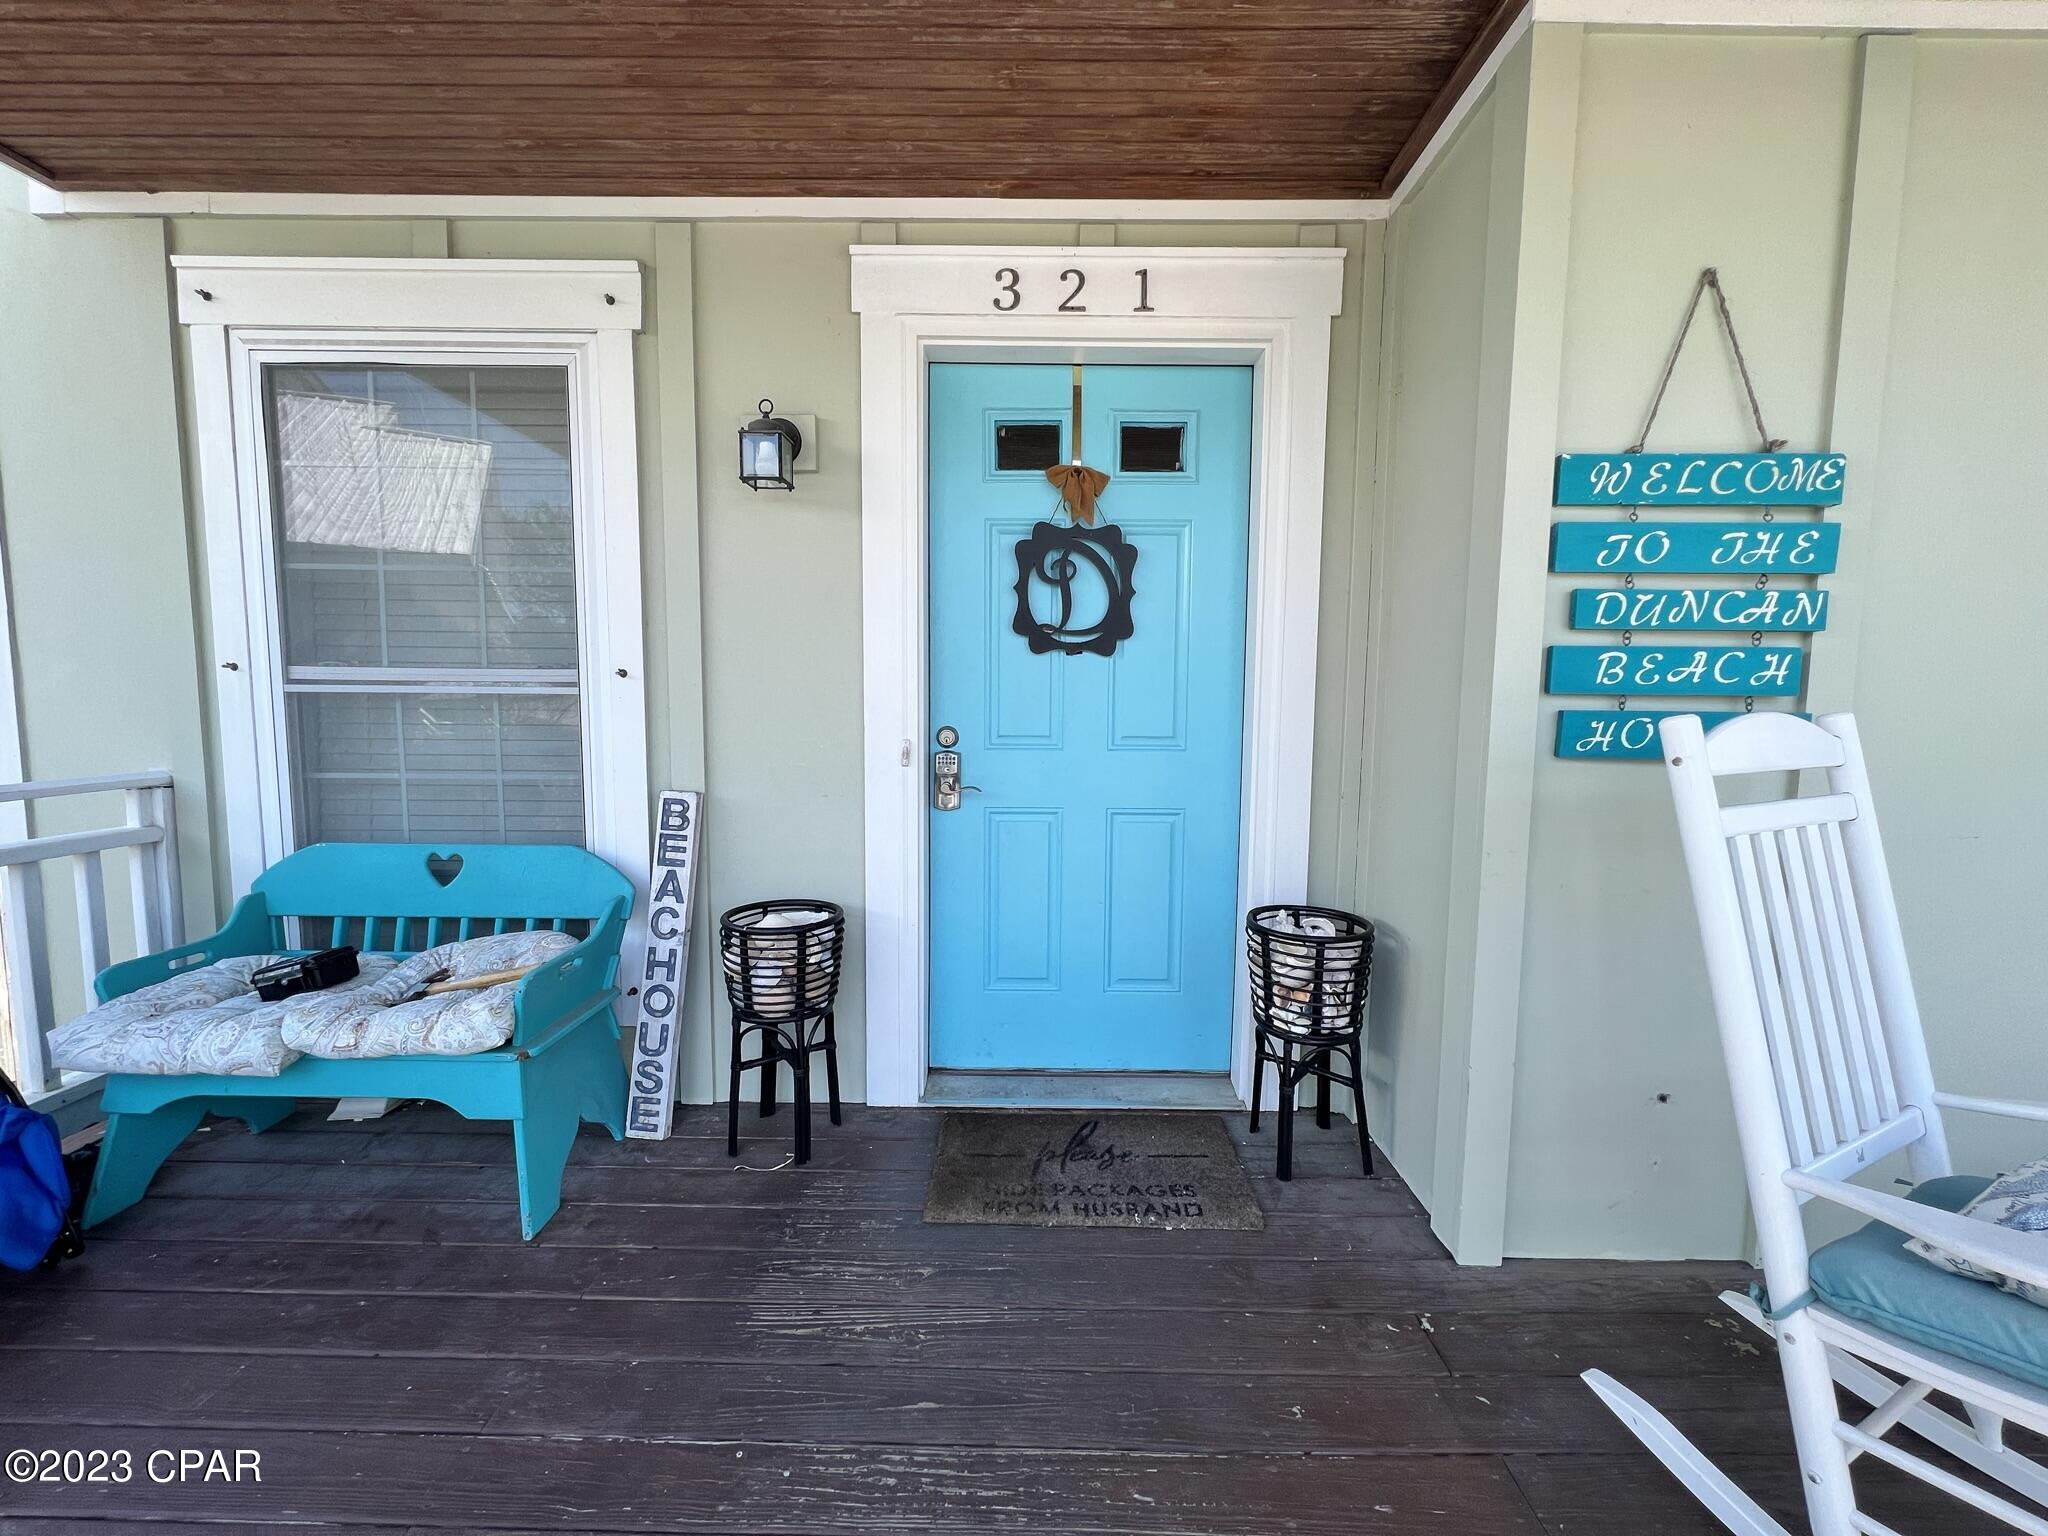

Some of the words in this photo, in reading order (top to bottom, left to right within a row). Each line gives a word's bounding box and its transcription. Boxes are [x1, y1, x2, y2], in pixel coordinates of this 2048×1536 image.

[993, 267, 1155, 312] 321
[1589, 457, 1846, 495] WELCOME
[1596, 530, 1671, 567] TO
[1711, 529, 1820, 565] THE
[1594, 589, 1825, 627] DUNCAN
[1595, 650, 1794, 687] BEACH
[628, 797, 691, 1134] BEACHOUSE
[1053, 1183, 1198, 1198] PACKAGES
[1072, 1201, 1204, 1218] HUSBAND
